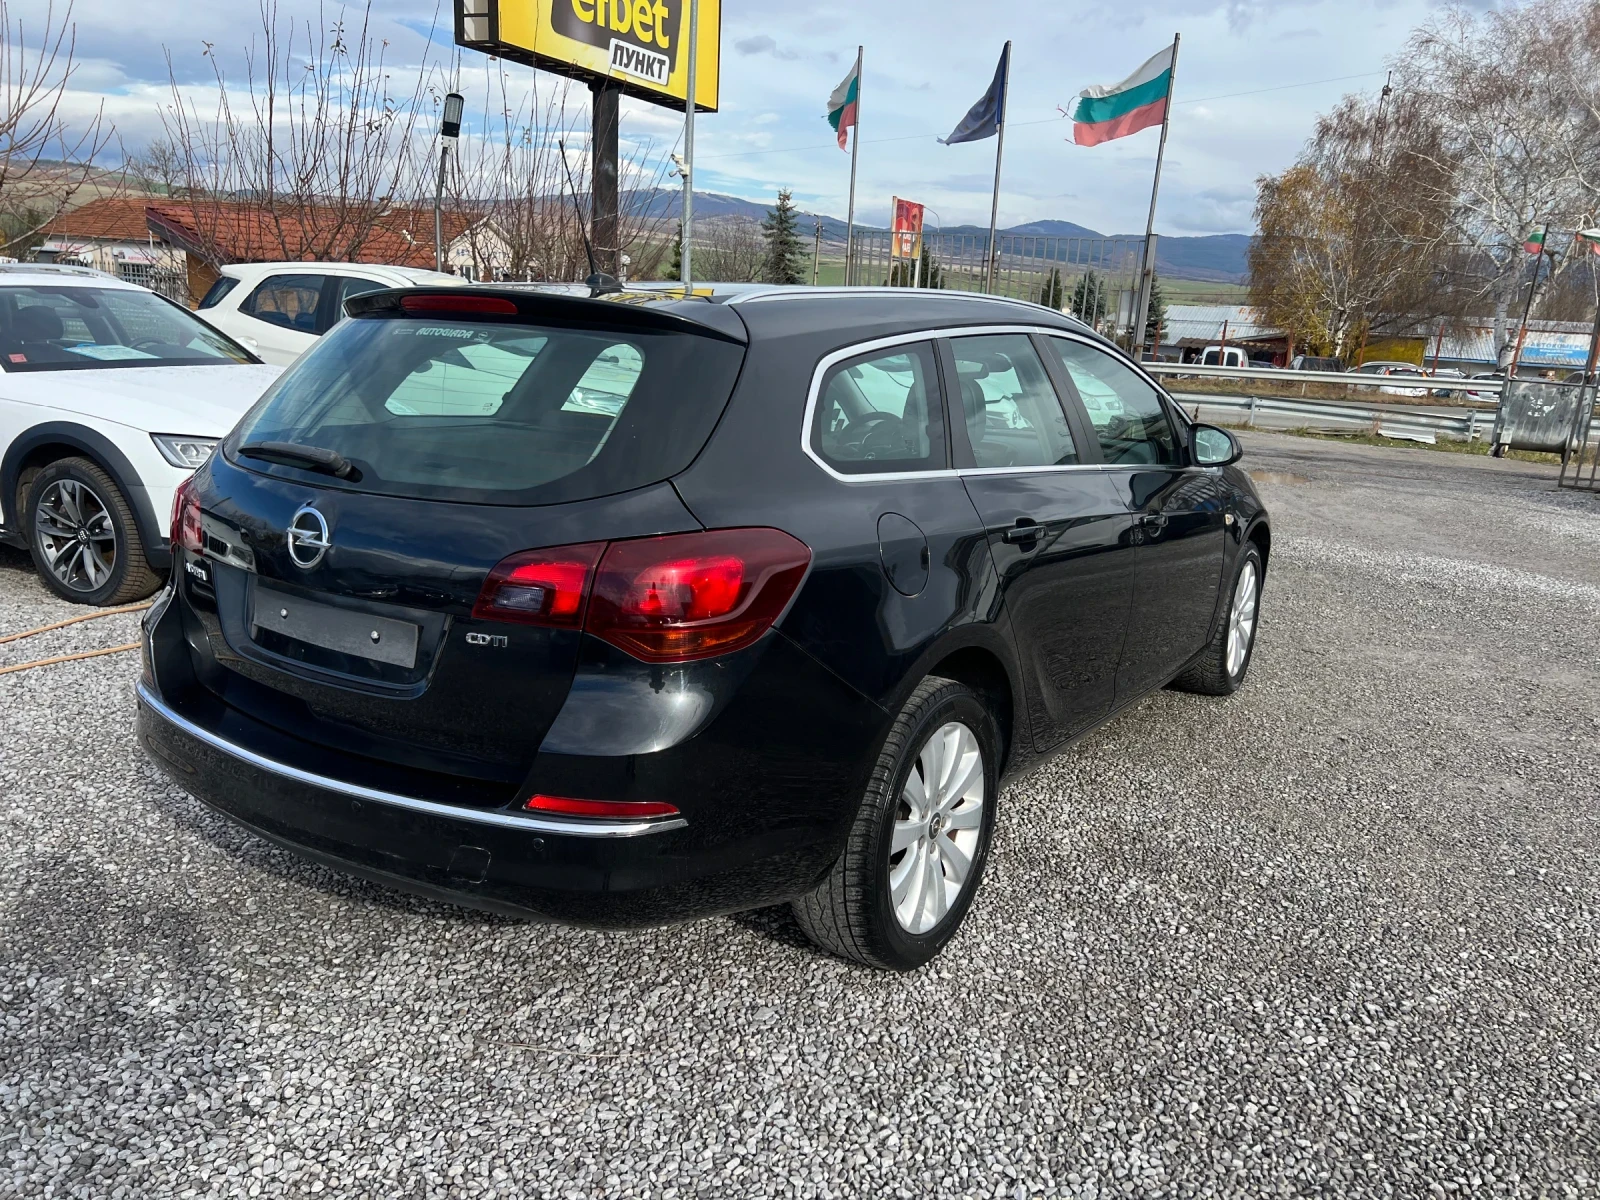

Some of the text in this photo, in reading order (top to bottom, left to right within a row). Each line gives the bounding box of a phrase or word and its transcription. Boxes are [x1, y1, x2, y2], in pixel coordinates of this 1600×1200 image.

[612, 43, 666, 79] ПУНКТ
[416, 327, 474, 339] AUTOGIADA
[465, 632, 508, 648] CDTI
